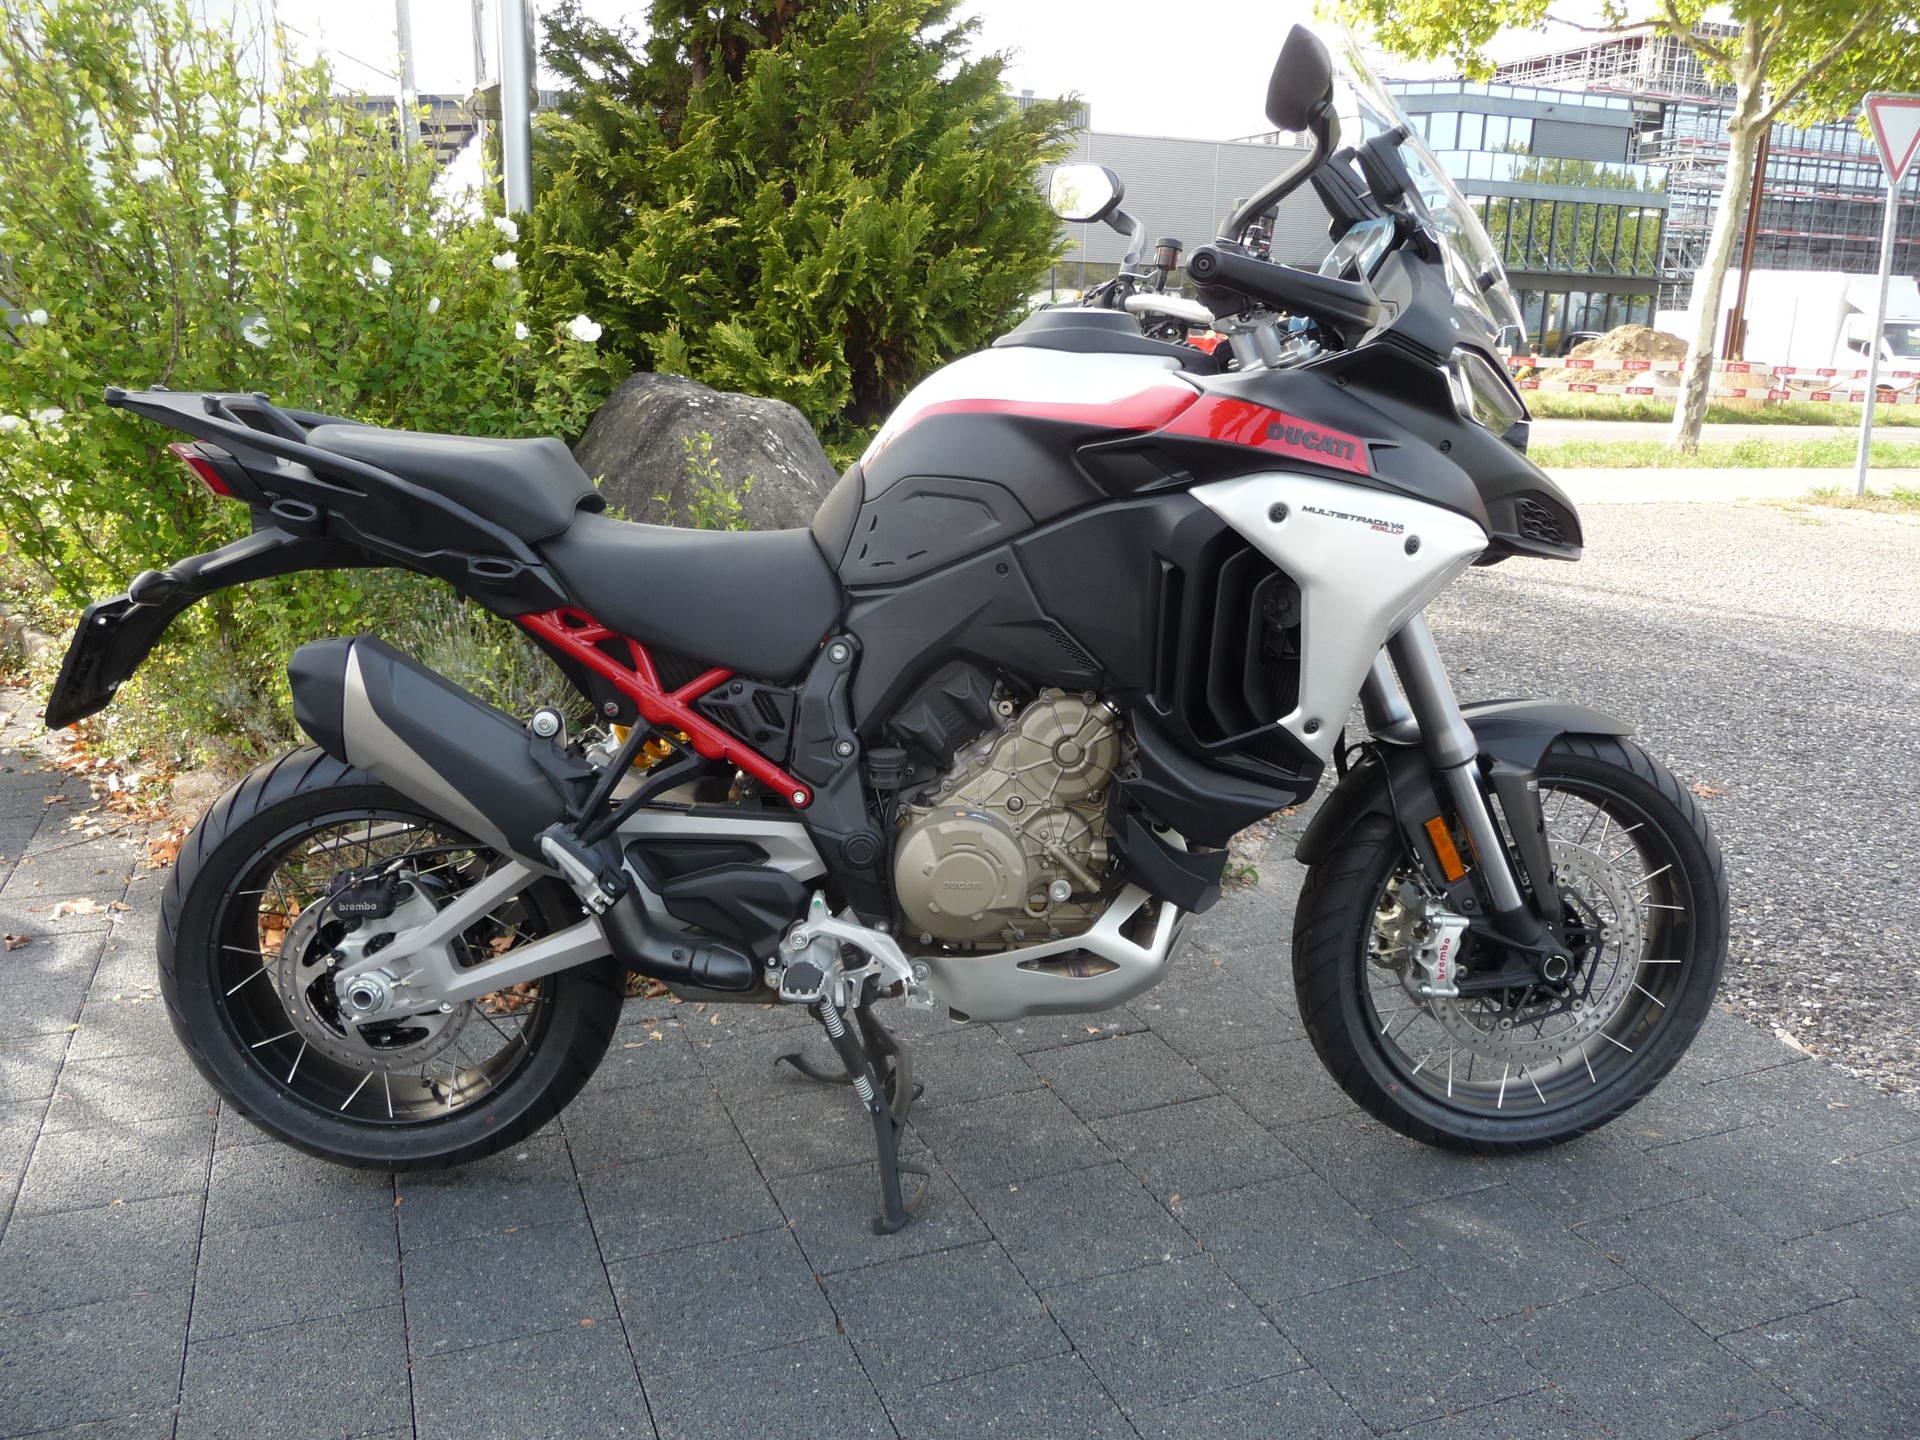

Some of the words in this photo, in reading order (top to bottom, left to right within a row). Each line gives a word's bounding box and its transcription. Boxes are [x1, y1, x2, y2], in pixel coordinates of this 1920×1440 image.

[1267, 421, 1356, 461] DUCATI
[1301, 504, 1390, 528] MULTISTRADA
[1371, 524, 1404, 535] RALLY
[942, 880, 982, 890] DUCATI
[338, 901, 378, 912] brembo
[1436, 937, 1451, 981] brembo
